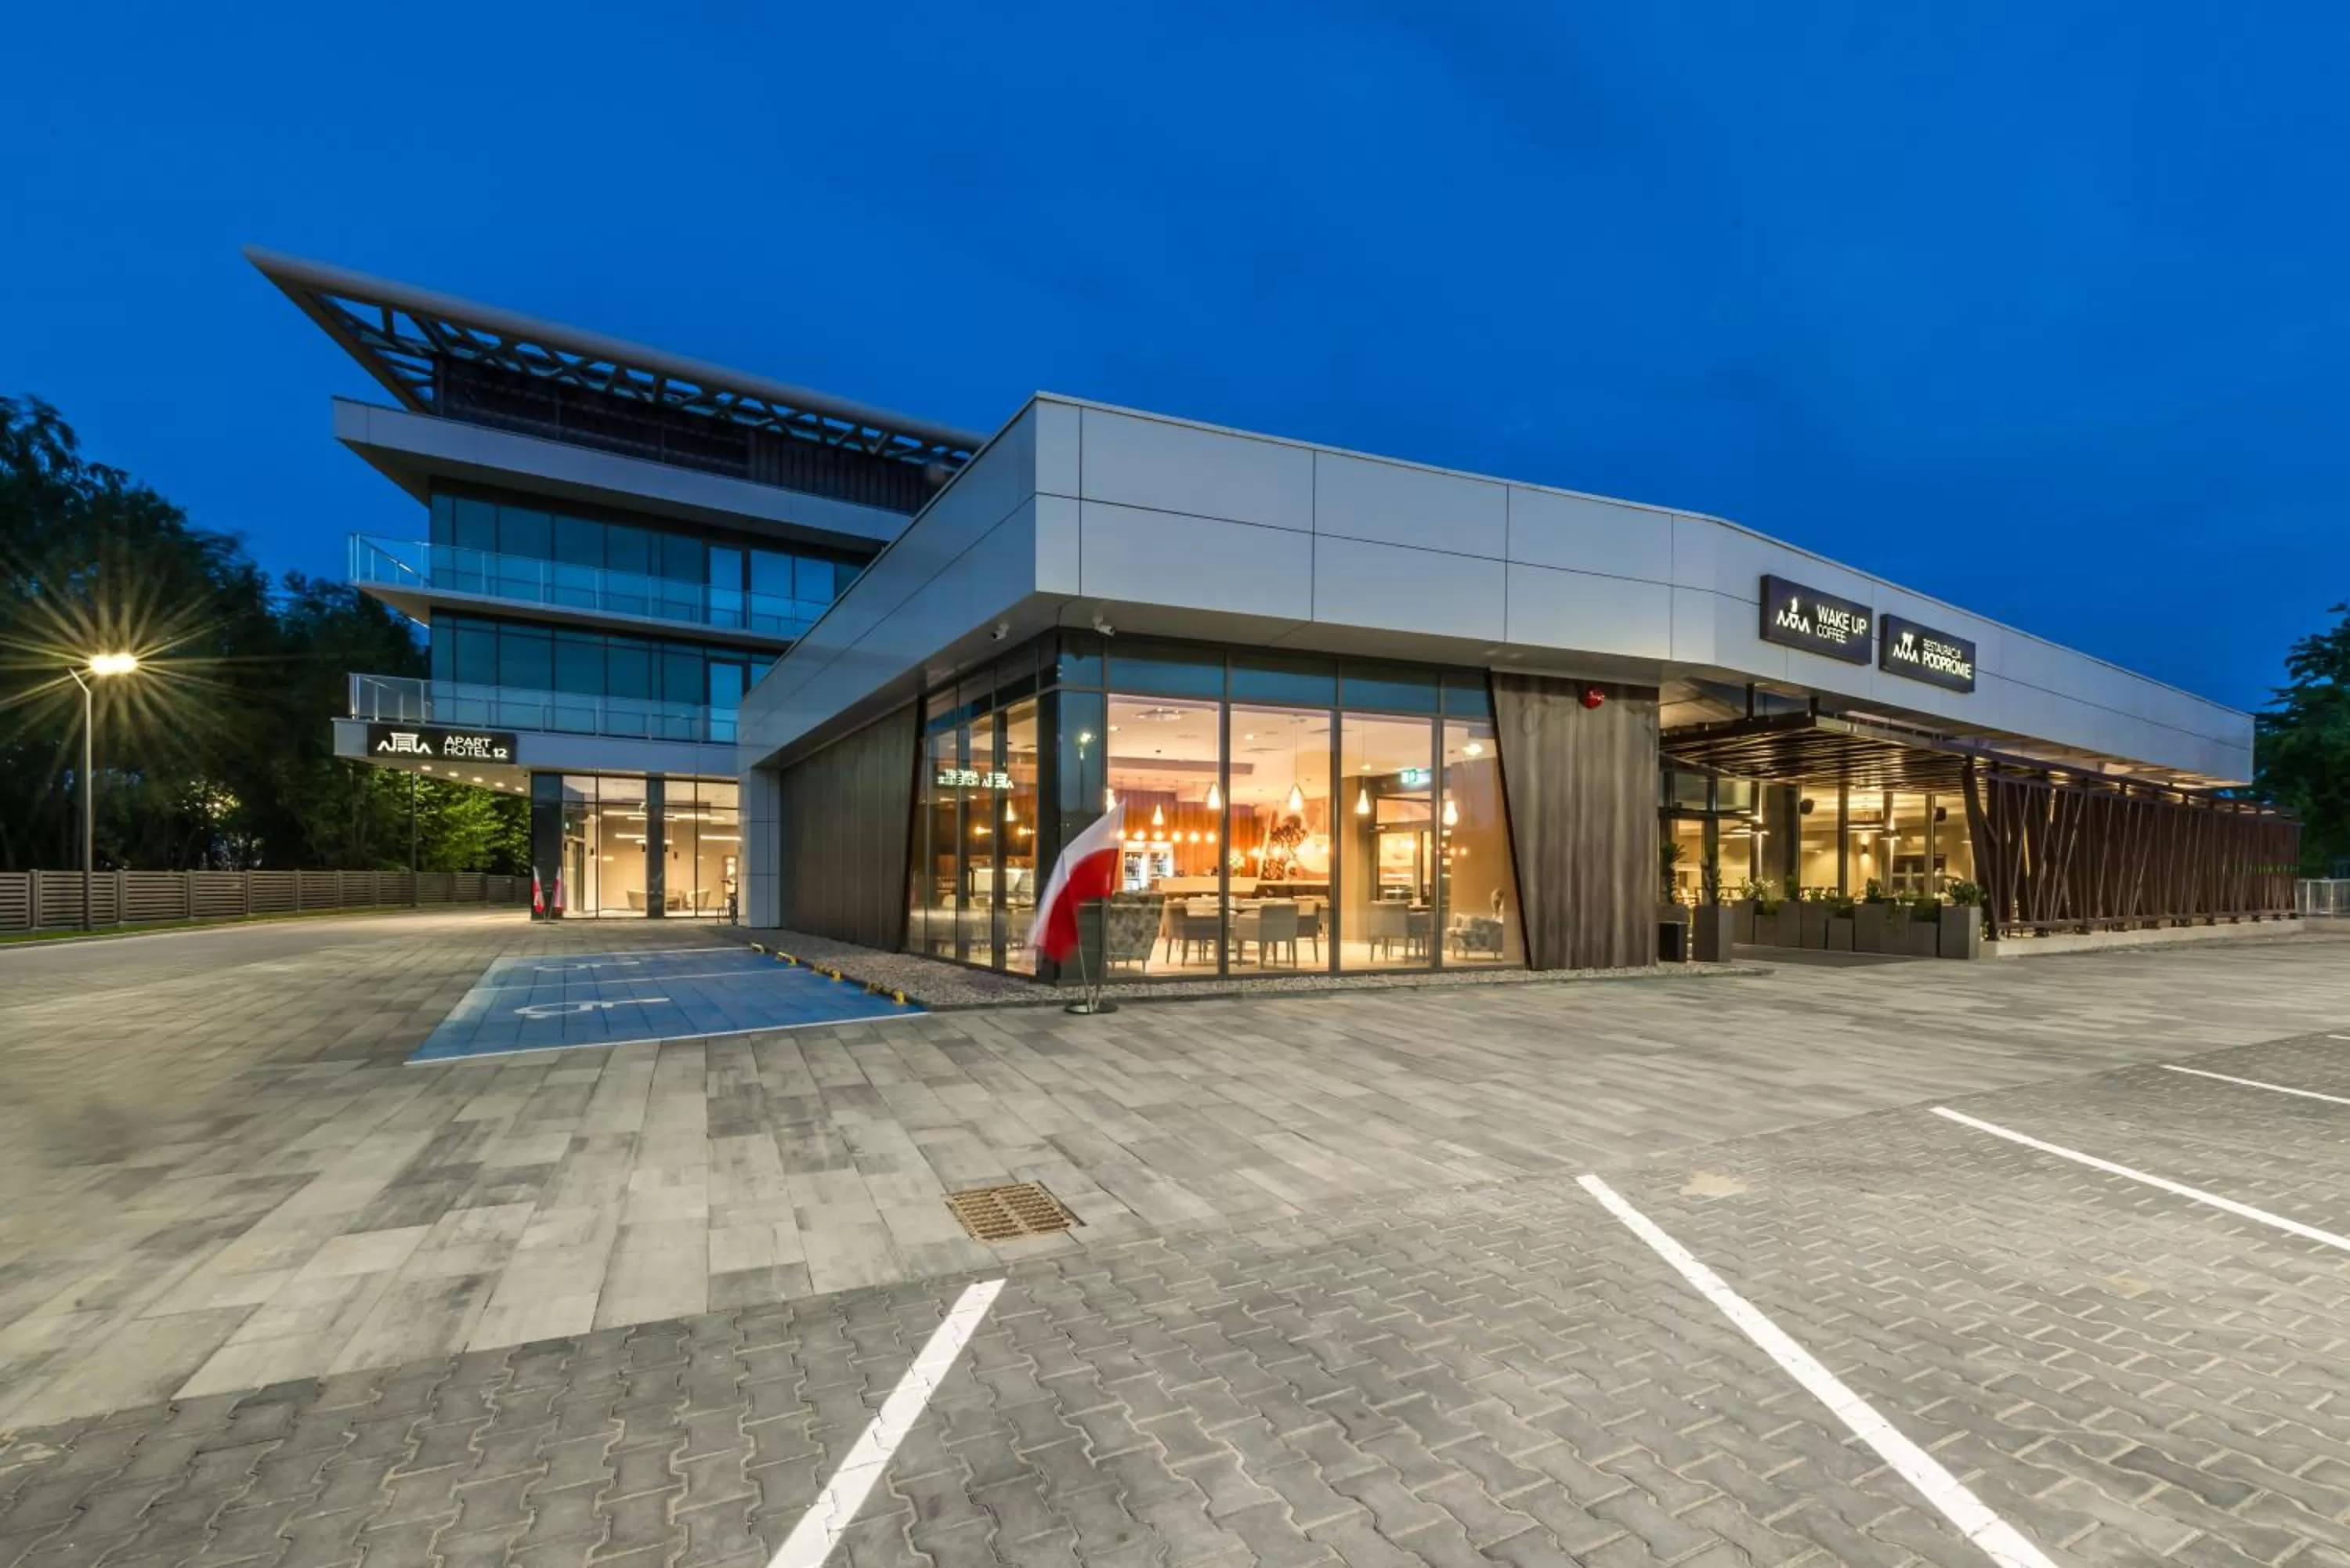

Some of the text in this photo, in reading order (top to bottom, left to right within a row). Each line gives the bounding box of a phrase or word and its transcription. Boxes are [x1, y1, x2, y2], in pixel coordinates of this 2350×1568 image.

[1817, 604, 1867, 635] WAKE UP
[1817, 624, 1846, 644] COFFEE
[444, 735, 492, 747] APART
[444, 746, 508, 758] HOTEL 12
